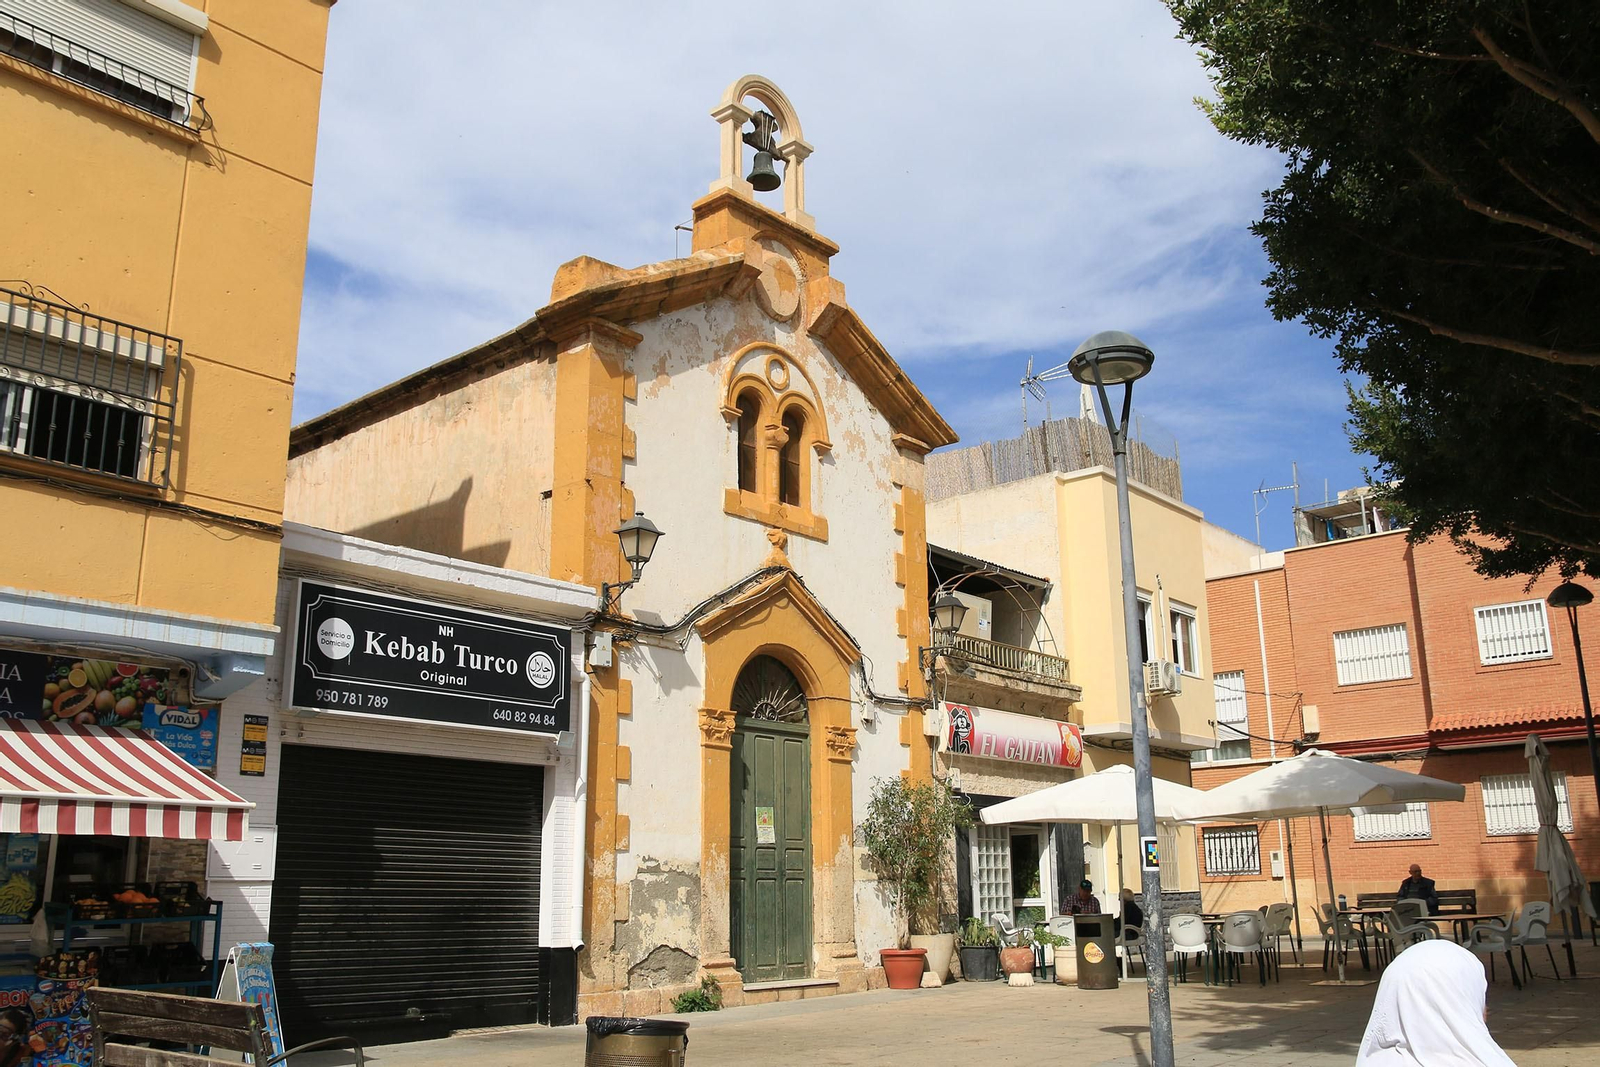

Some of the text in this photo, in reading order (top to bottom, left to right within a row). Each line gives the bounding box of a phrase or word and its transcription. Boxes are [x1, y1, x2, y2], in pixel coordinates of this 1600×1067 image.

[320, 629, 345, 639] Servicio
[438, 625, 454, 637] NH
[320, 638, 351, 649] Domicilio
[363, 630, 518, 675] Kebab Turco
[530, 658, 551, 673] حلال
[420, 670, 467, 686] Original
[532, 672, 549, 680] HALAL
[316, 689, 389, 708] 950 781 789
[166, 714, 197, 724] VIDAL
[493, 708, 555, 726] 640 82 94 84
[177, 733, 193, 741] Vida
[981, 733, 998, 758] EL
